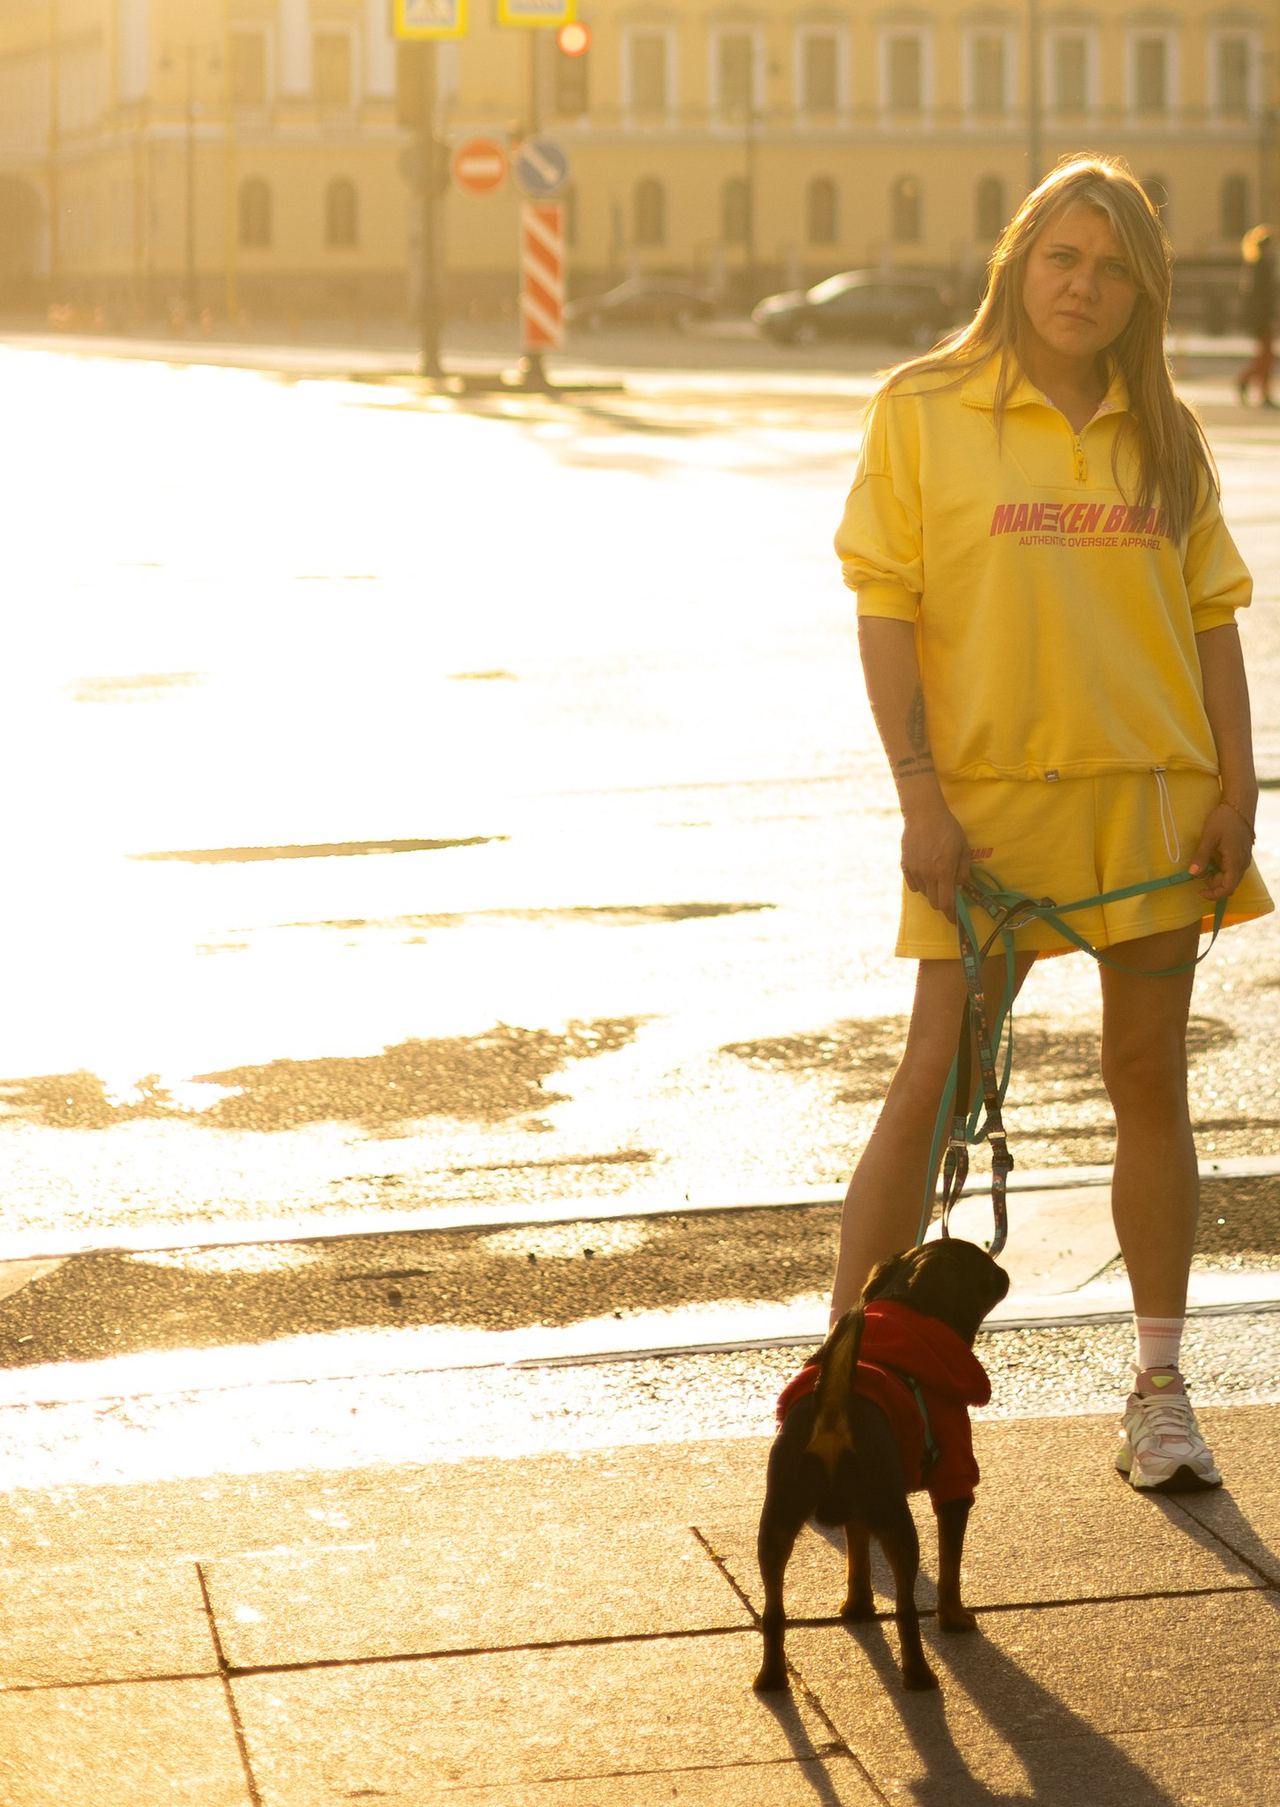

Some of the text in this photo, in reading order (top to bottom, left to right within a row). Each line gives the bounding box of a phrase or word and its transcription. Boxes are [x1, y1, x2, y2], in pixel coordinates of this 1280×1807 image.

[990, 503, 1105, 537] MANEKEN
[1019, 536, 1162, 551] AUTHENTIC OVERSIZE APPAREL
